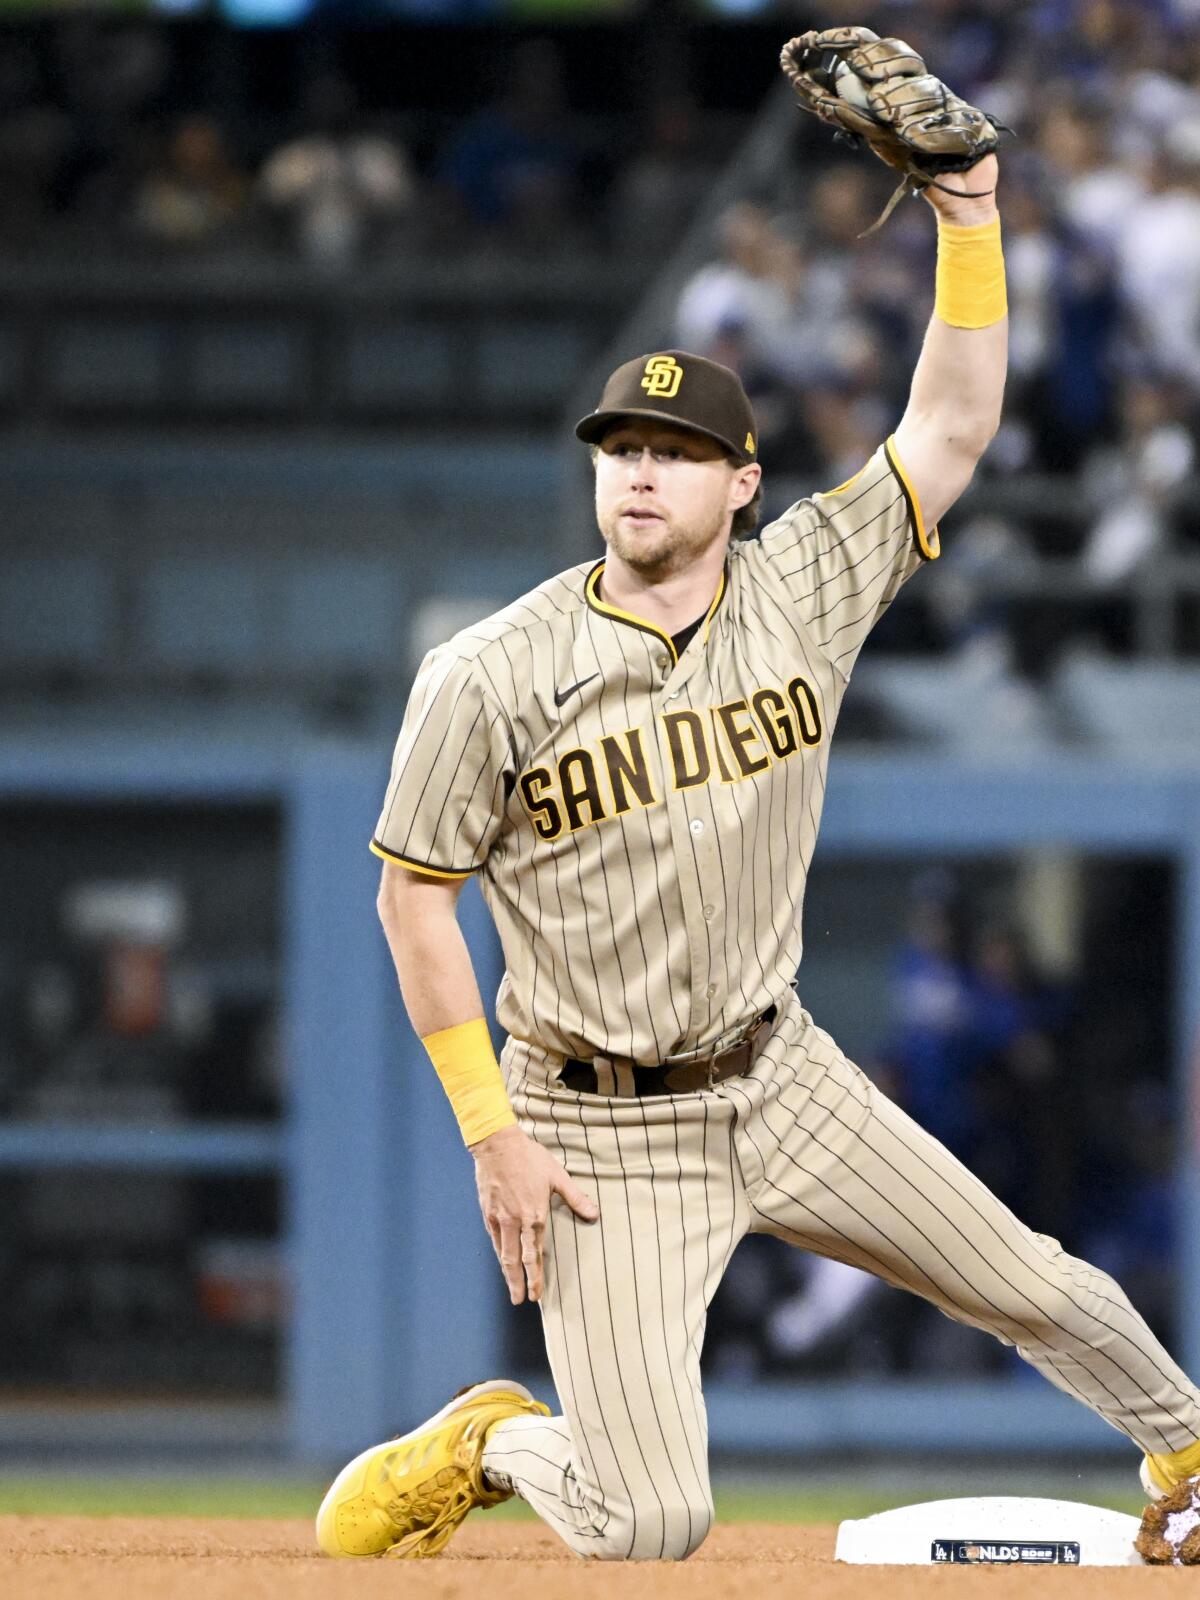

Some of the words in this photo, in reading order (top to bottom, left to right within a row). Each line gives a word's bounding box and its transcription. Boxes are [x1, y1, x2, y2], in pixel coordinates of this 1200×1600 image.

[640, 355, 684, 398] SD
[518, 726, 656, 842] SAN
[660, 676, 822, 793] DIEGO
[979, 1545, 1019, 1561] NLDS
